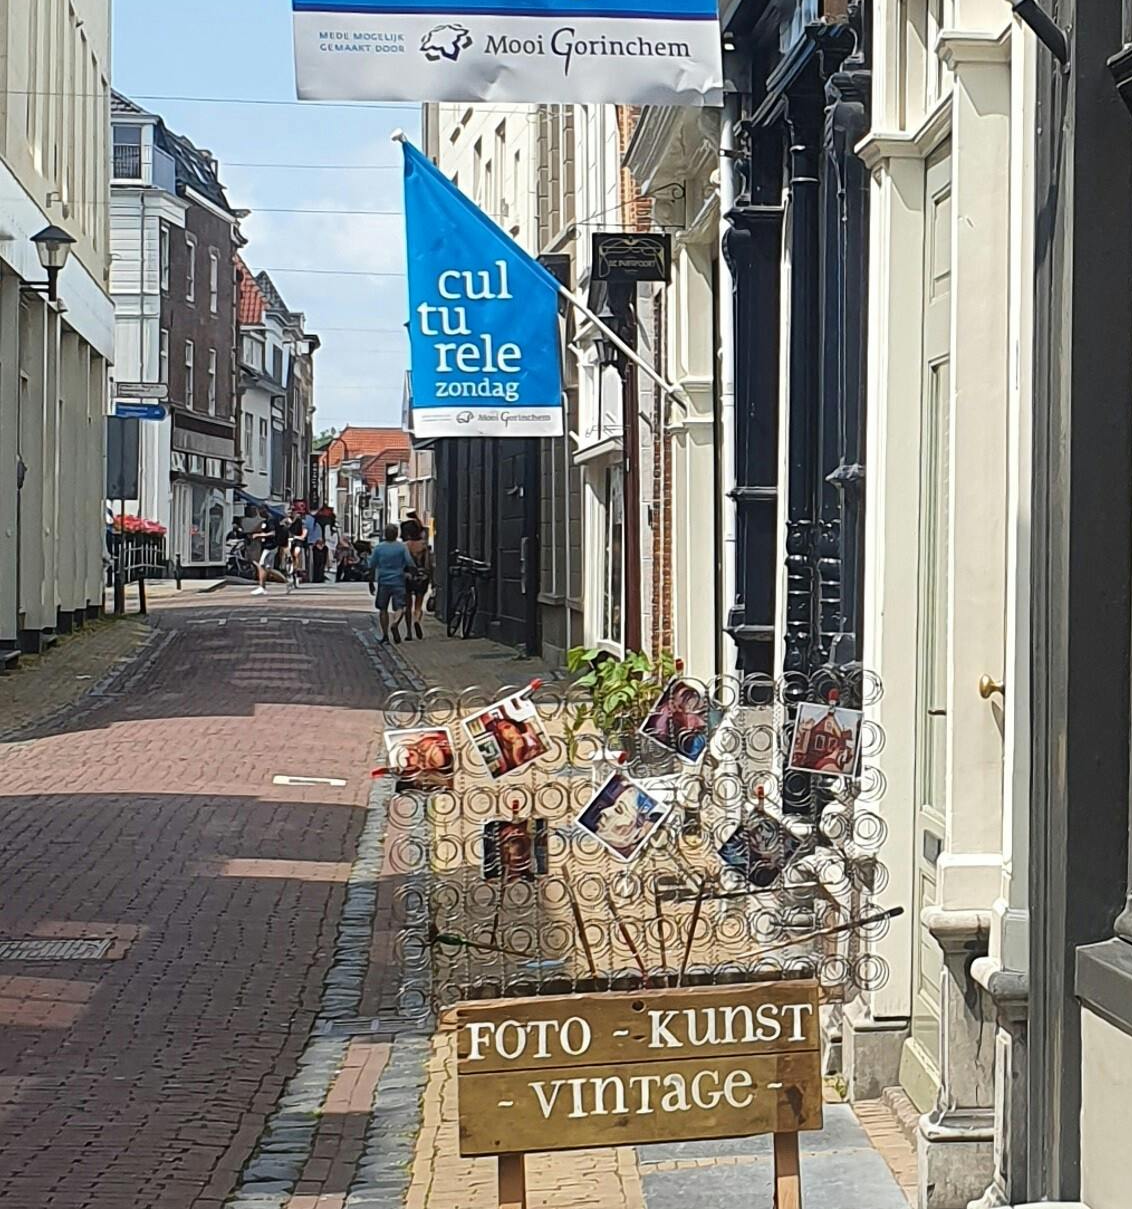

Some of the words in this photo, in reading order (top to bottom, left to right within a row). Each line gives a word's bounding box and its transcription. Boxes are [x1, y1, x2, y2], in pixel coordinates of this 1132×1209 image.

[319, 31, 349, 41] MEDE
[353, 32, 405, 42] MOGELIJK
[319, 43, 371, 53] GEMAAKT
[375, 44, 405, 53] DOOR
[484, 34, 545, 55] Mooi
[550, 28, 691, 75] Gorinchem
[438, 260, 514, 301] cul
[416, 301, 472, 336] tu
[434, 334, 522, 373] rele
[435, 377, 520, 403] zondag
[466, 1017, 592, 1061] FOTO
